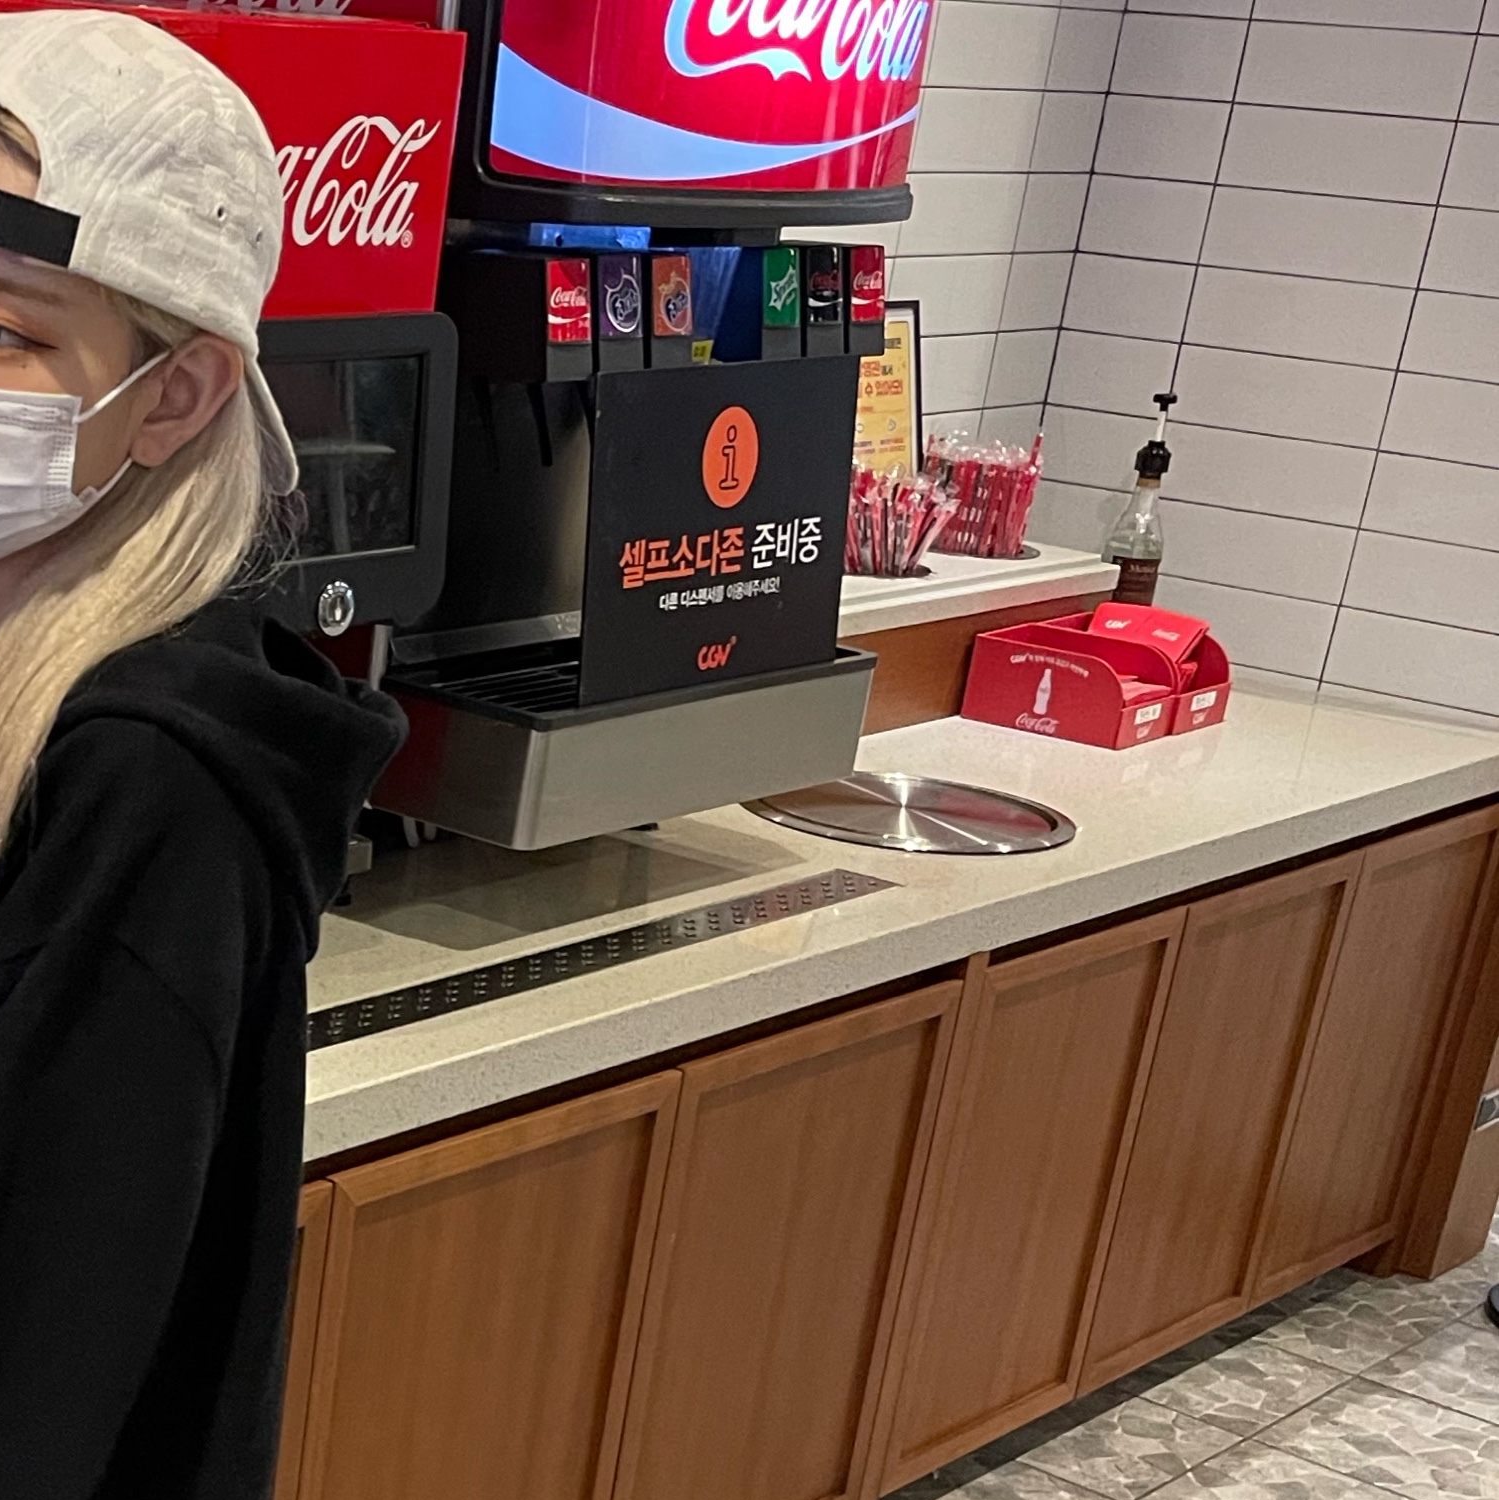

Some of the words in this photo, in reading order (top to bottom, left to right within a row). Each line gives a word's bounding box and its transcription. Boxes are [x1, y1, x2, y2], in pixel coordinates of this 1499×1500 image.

[276, 115, 442, 246] a-Cola
[619, 526, 745, 589] 셀프소다존
[751, 516, 822, 570] 준비중
[659, 591, 678, 611] 다른
[680, 585, 724, 608] 디스펜서를
